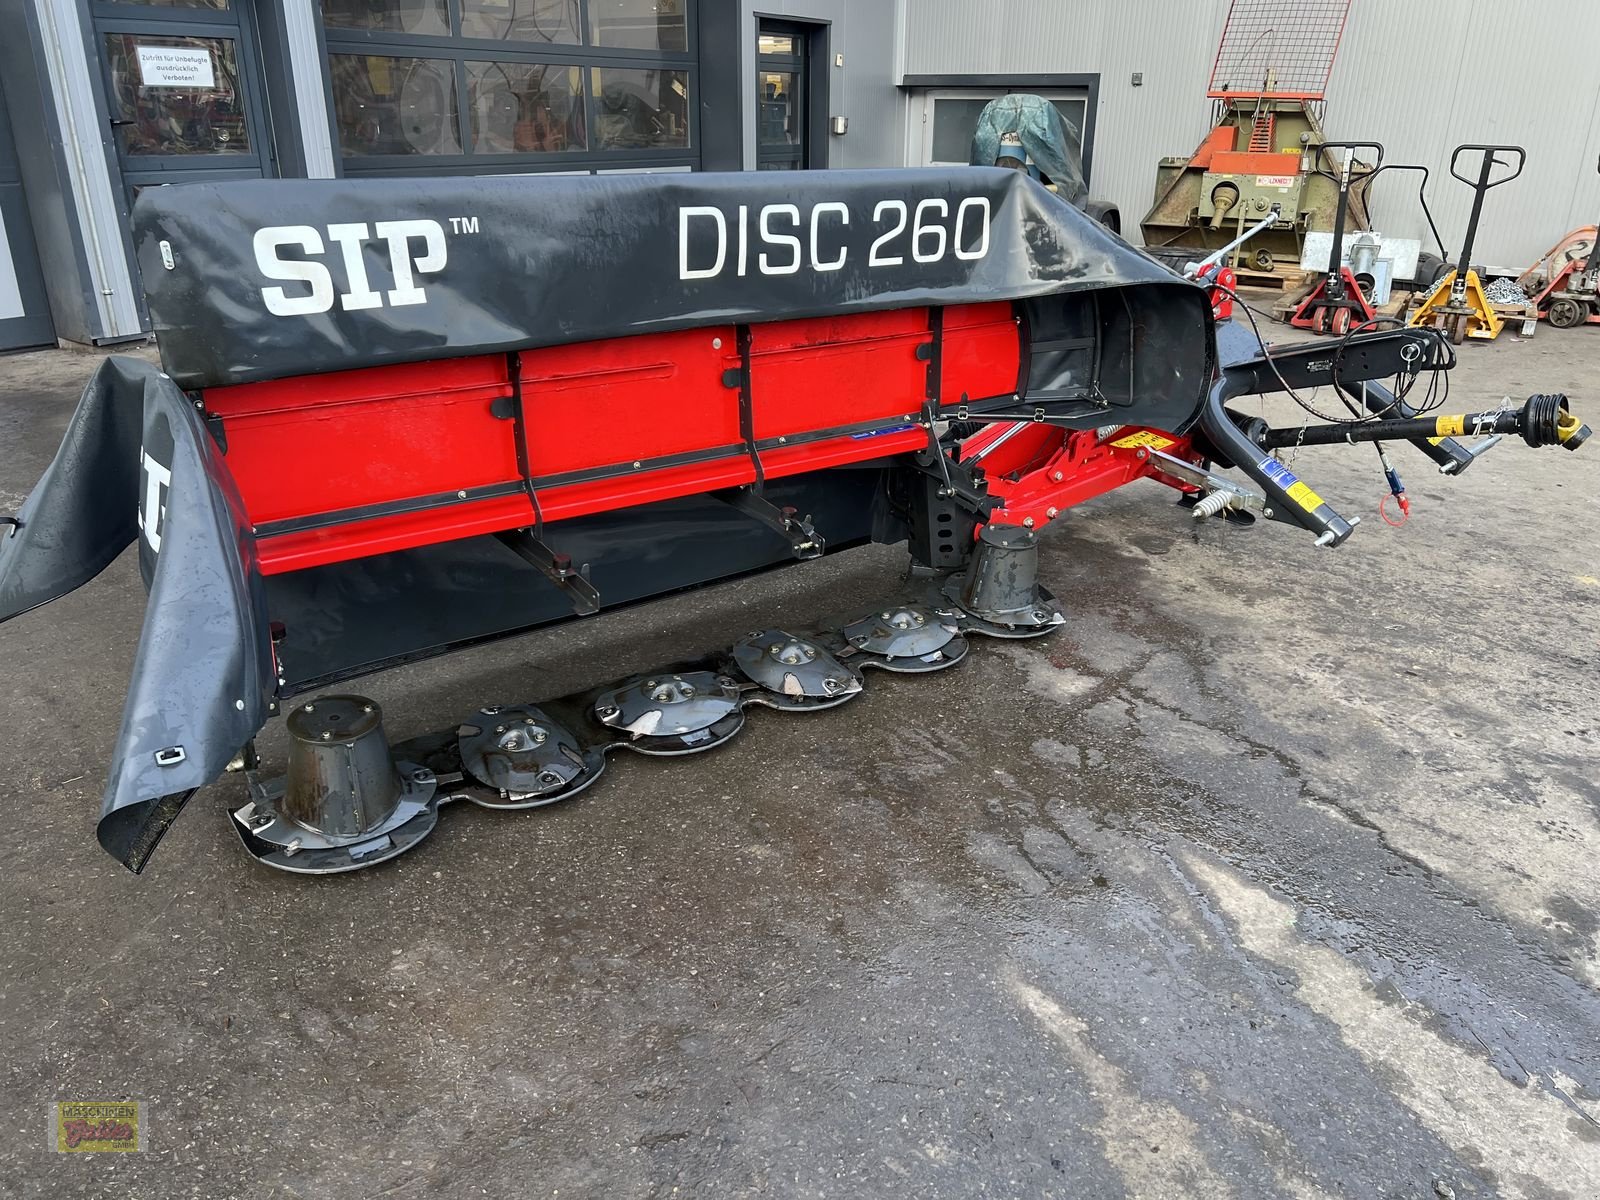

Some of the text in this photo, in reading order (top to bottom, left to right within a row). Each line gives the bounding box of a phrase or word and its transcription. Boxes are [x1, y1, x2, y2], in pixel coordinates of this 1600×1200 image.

[175, 56, 208, 64] Unbefugte
[253, 219, 447, 317] SIP
[679, 197, 990, 280] DISC 260
